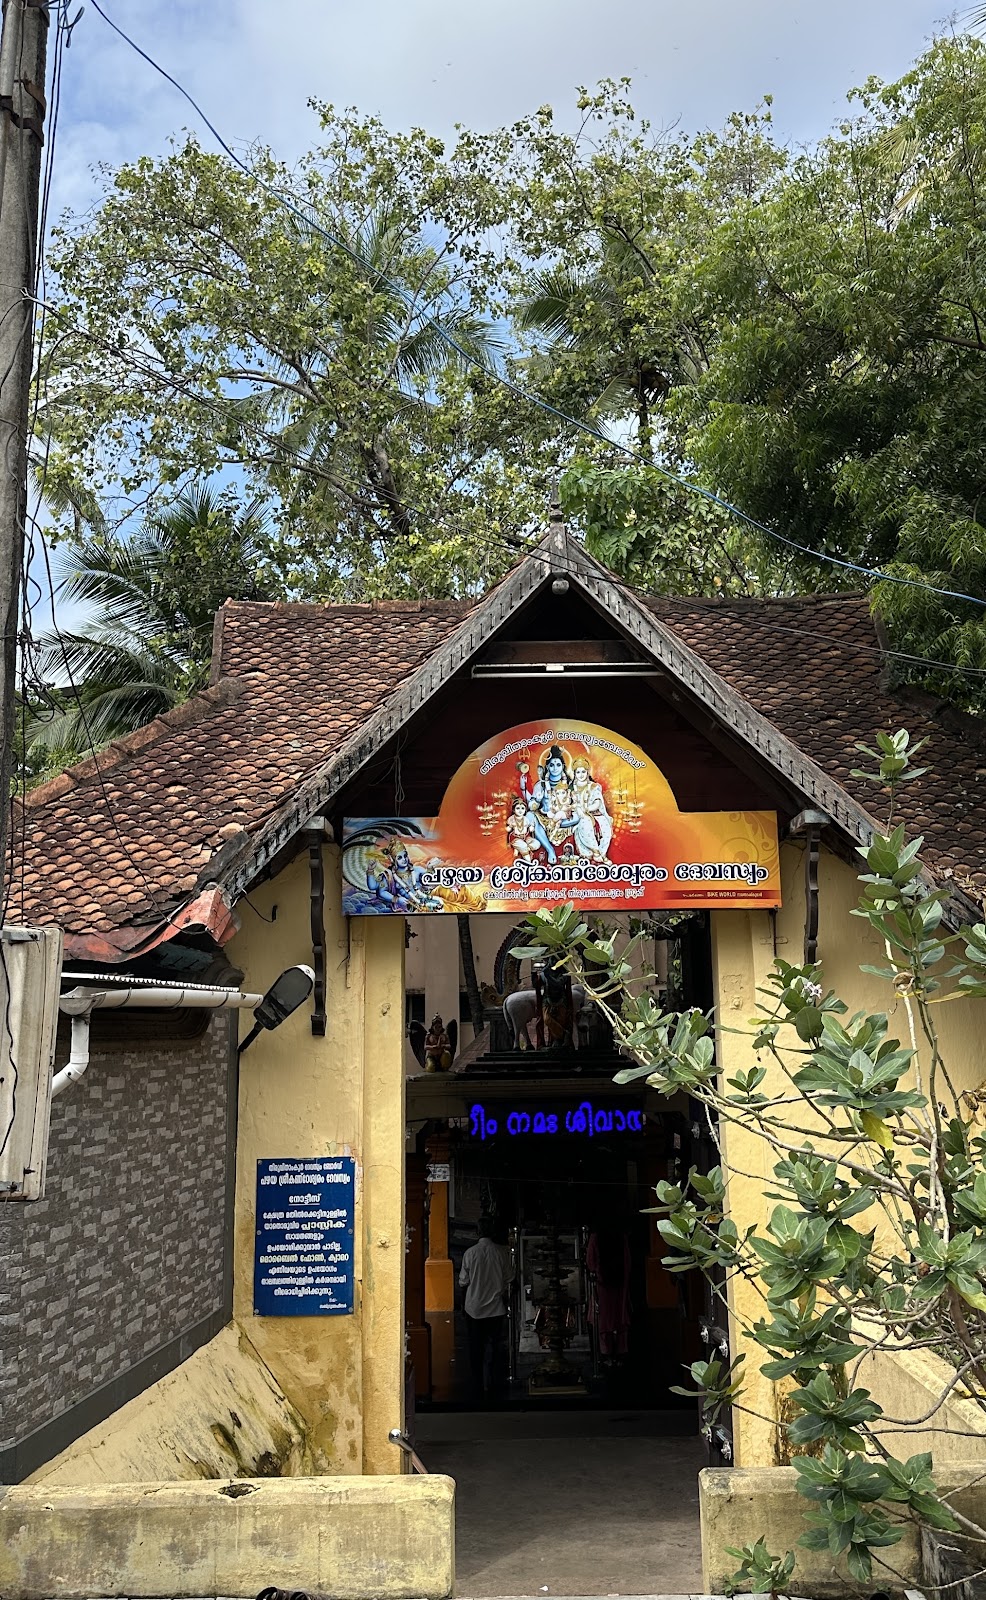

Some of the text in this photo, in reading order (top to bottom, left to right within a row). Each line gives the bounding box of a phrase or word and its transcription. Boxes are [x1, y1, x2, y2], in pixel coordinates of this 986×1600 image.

[480, 730, 554, 775] തിരുവിതാംകൂർ
[421, 859, 769, 889] പഴയ ശ്രീകണ്ഠേശ്വരം ദേവസ്വം
[567, 887, 623, 900] തിരുവനന്തപുരം
[261, 1175, 277, 1185] പഴയ
[326, 1173, 350, 1184] ദേവസ്വം
[289, 1193, 322, 1204] നോട്ടീസ്
[301, 1219, 347, 1231] പ്ലാസ്റ്റിക്
